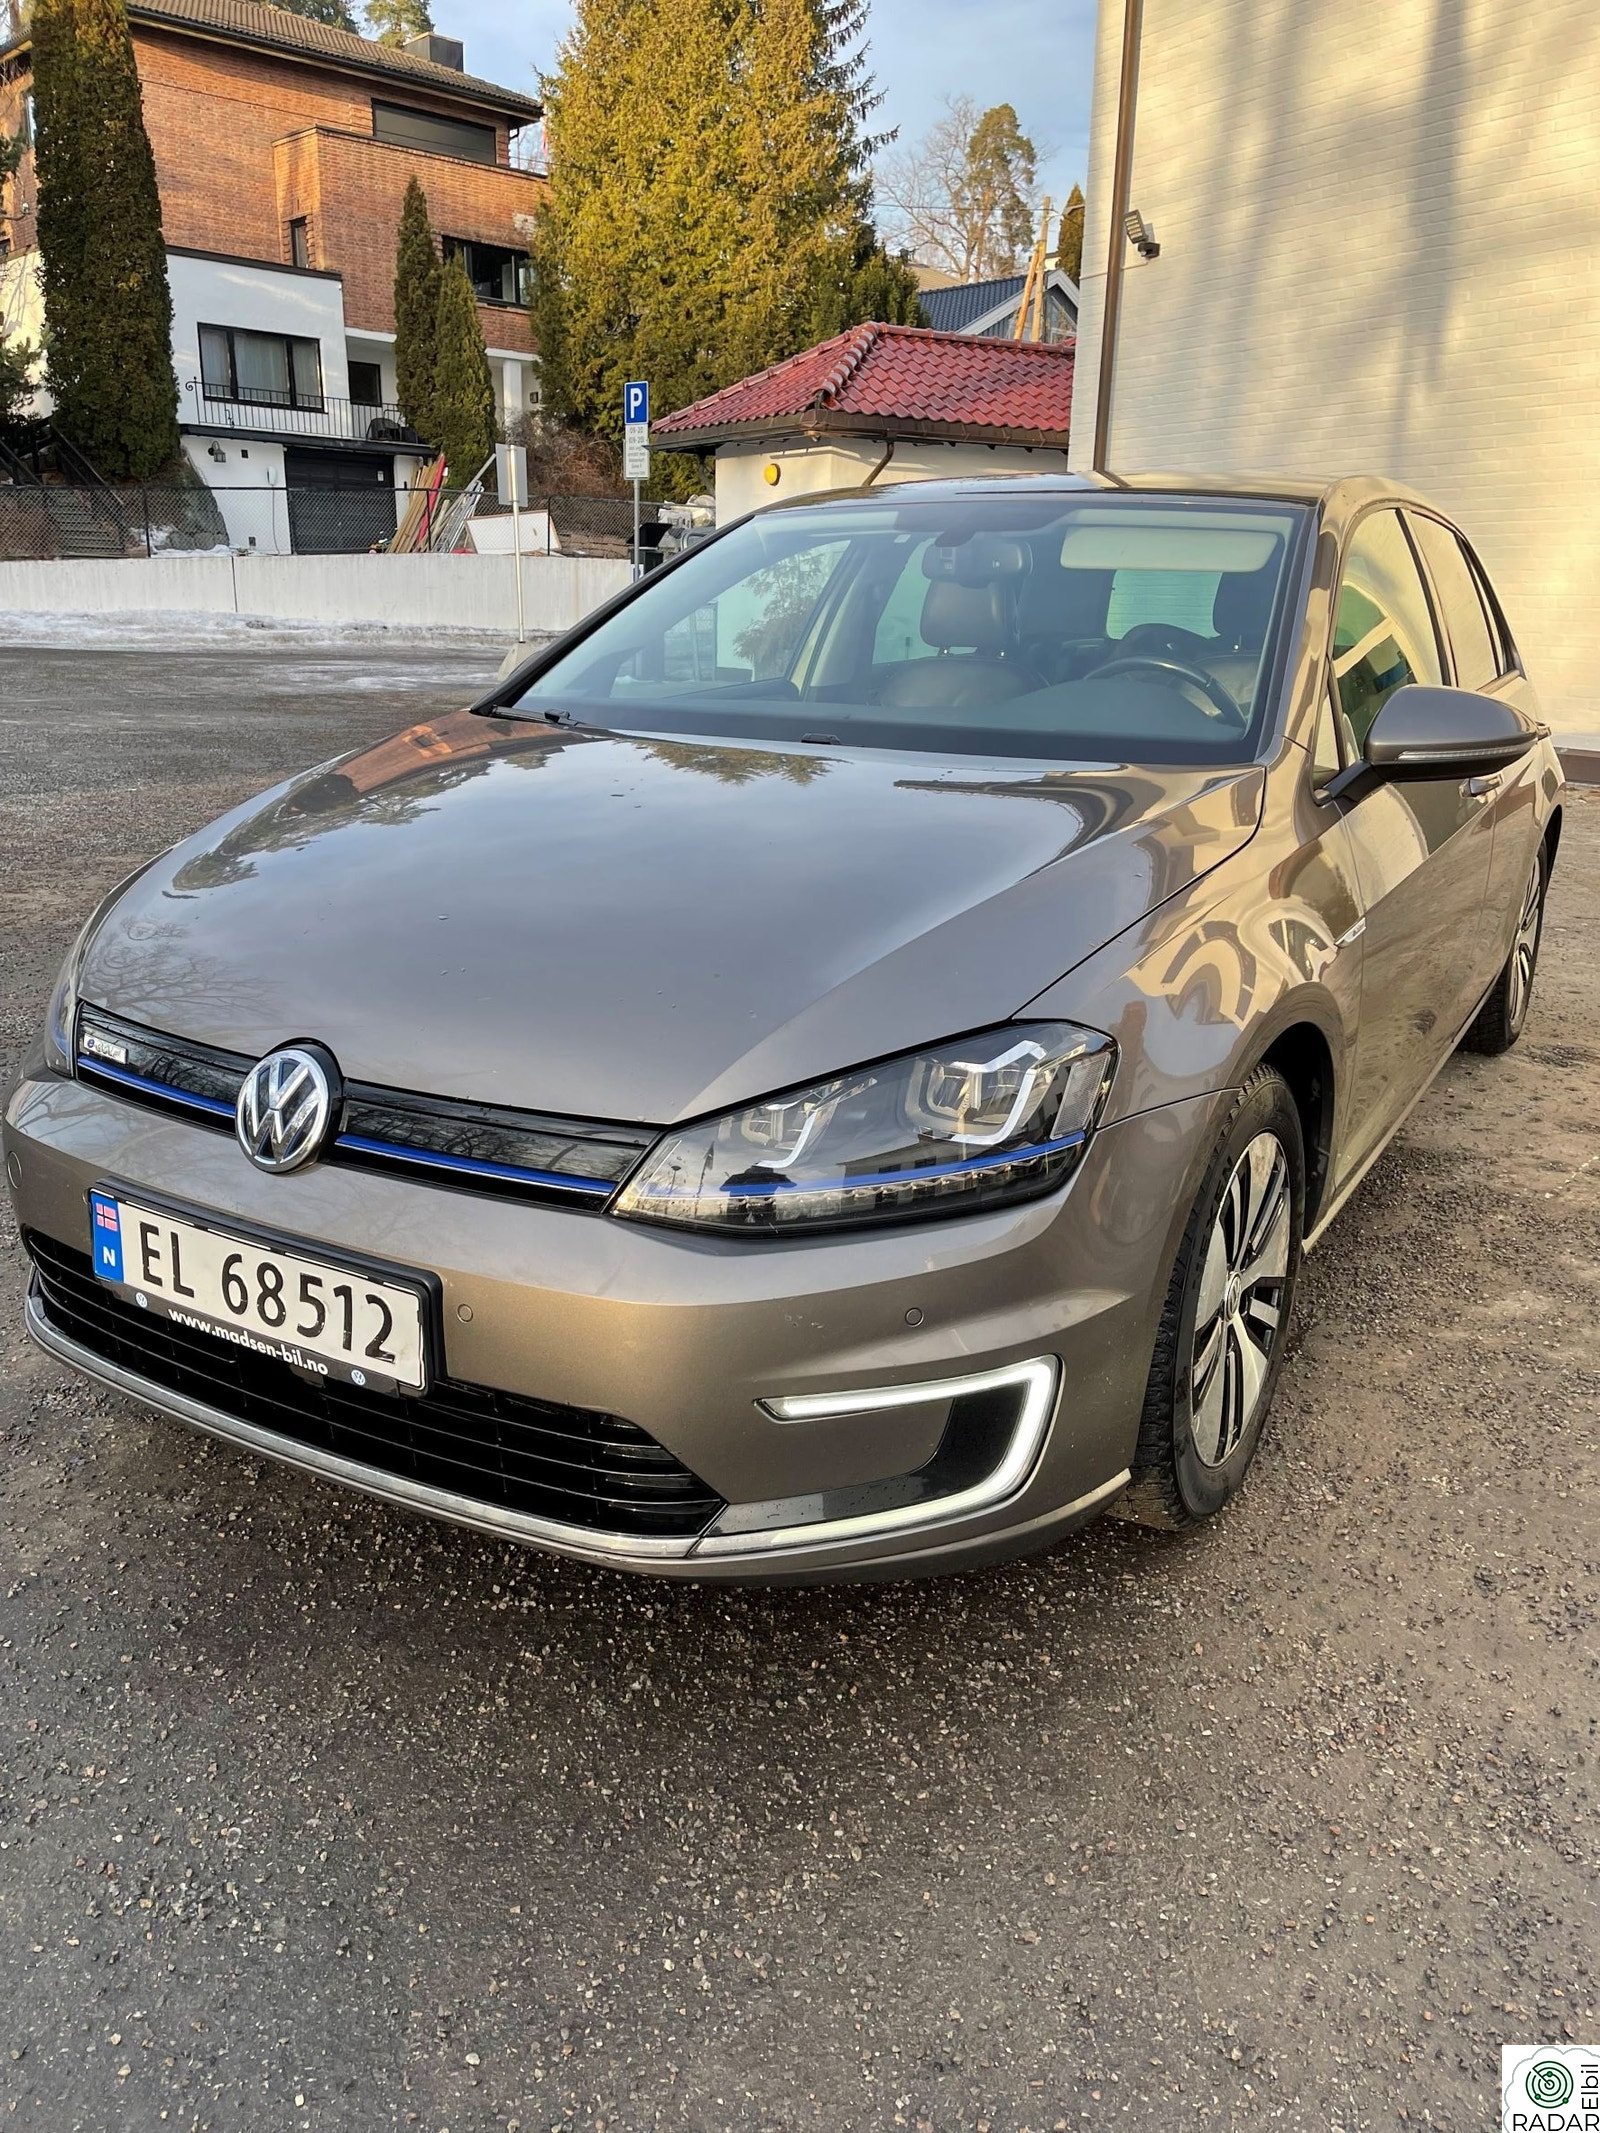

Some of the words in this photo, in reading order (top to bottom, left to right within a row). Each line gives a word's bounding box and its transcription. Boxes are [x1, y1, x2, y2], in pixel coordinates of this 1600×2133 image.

[630, 387, 643, 419] P
[102, 1246, 116, 1267] N
[139, 1221, 195, 1299] EL
[221, 1253, 396, 1364] 68512
[168, 1308, 329, 1376] www.madsen-bil.no
